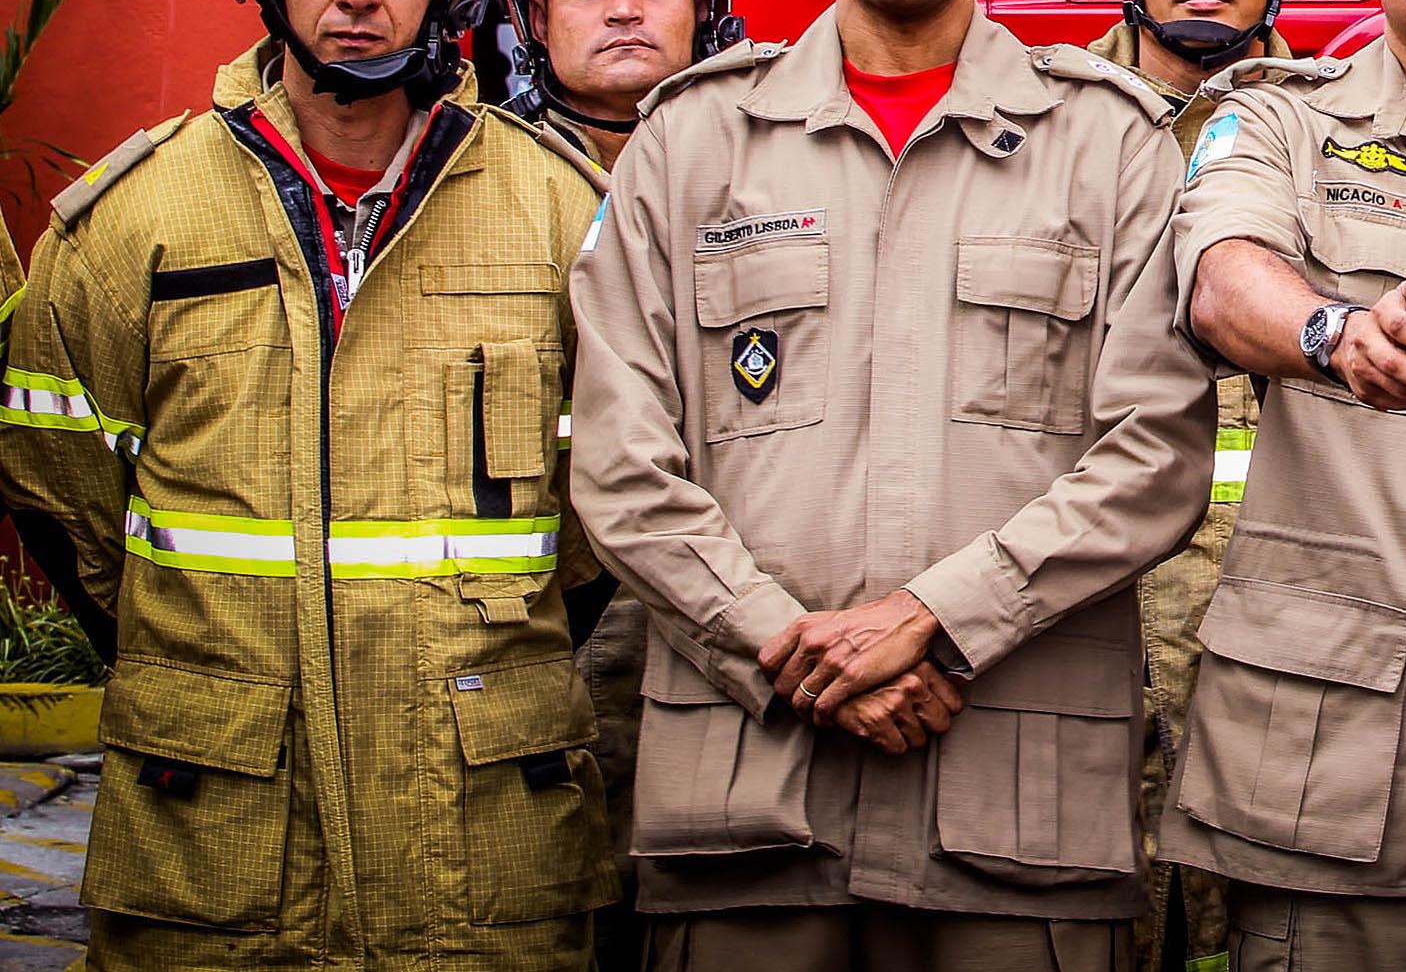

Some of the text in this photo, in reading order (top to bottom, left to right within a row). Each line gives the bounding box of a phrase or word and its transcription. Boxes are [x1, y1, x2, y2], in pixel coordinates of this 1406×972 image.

[1326, 188, 1386, 206] NICACIO
[704, 225, 754, 244] GILBERTO
[755, 218, 799, 234] LISBOA
